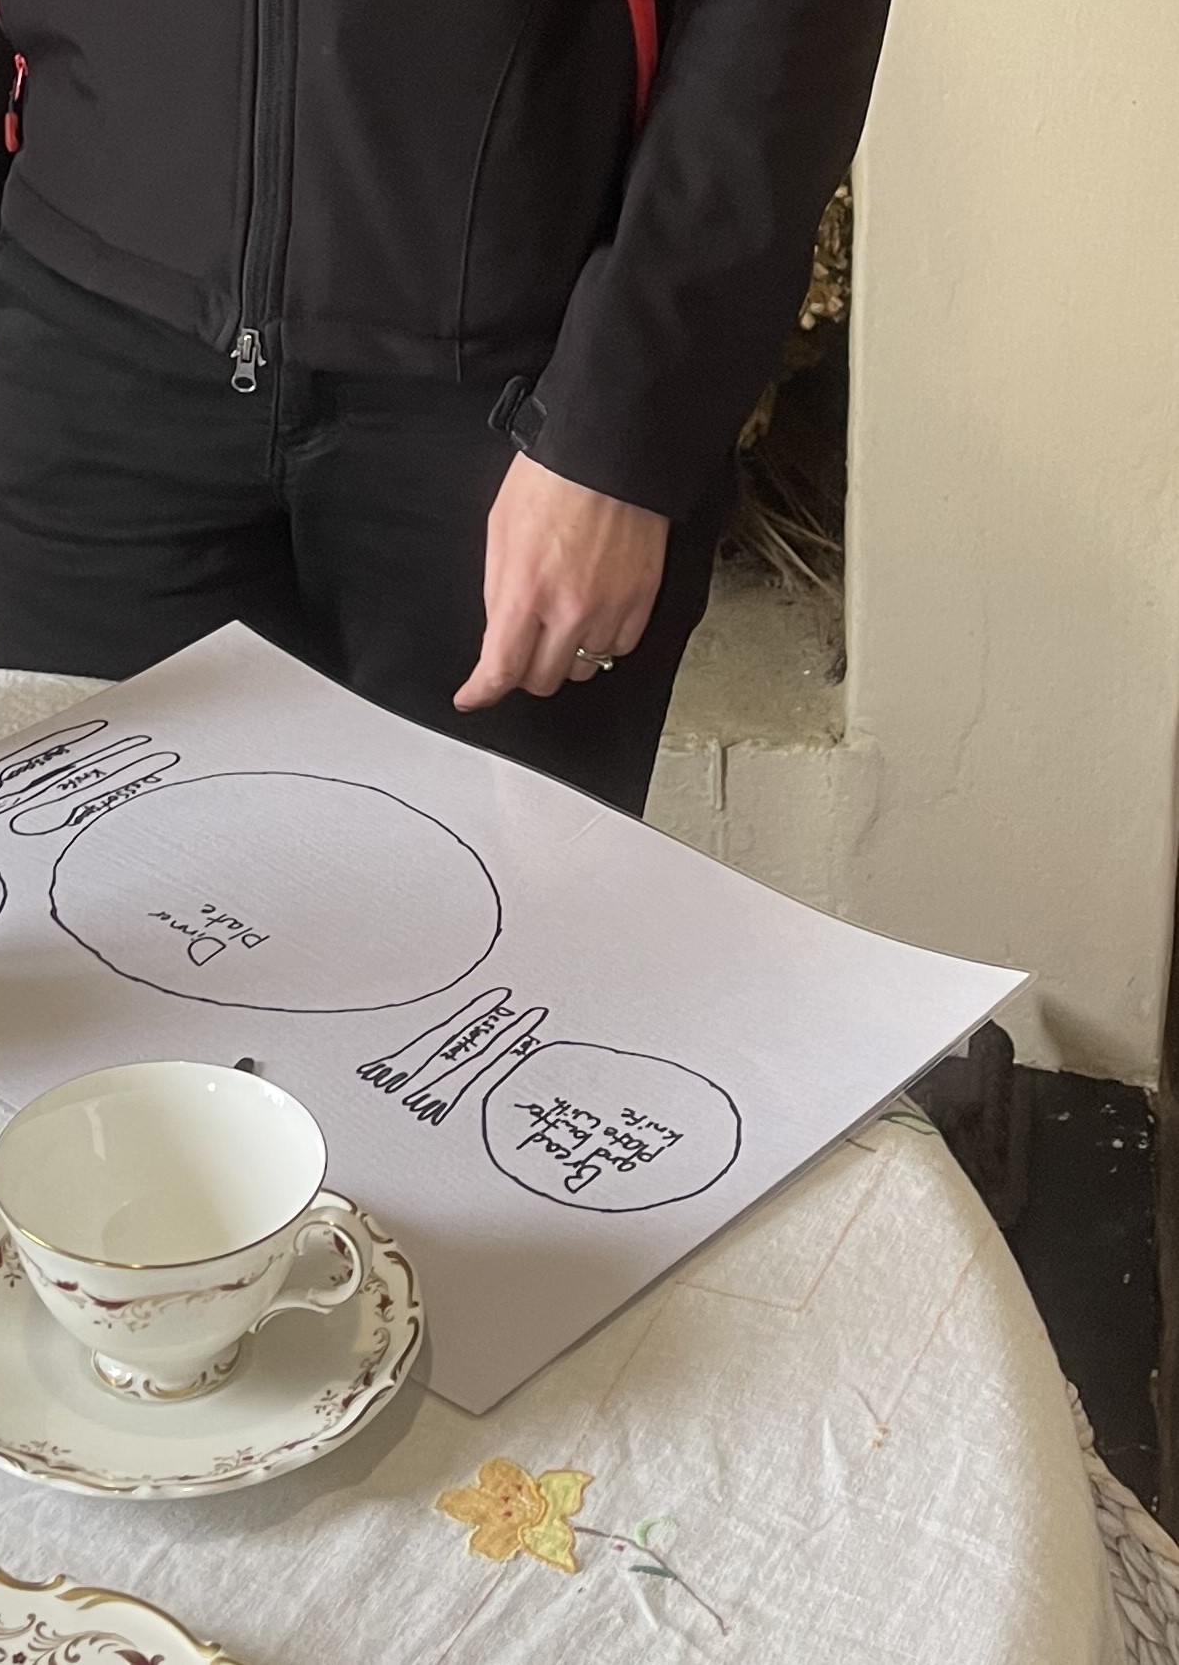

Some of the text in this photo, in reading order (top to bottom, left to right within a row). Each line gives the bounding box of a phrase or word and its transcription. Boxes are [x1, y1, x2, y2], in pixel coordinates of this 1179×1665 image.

[147, 910, 227, 967] Dinner
[513, 1102, 637, 1173] and butter
[515, 1130, 602, 1194] Bread
